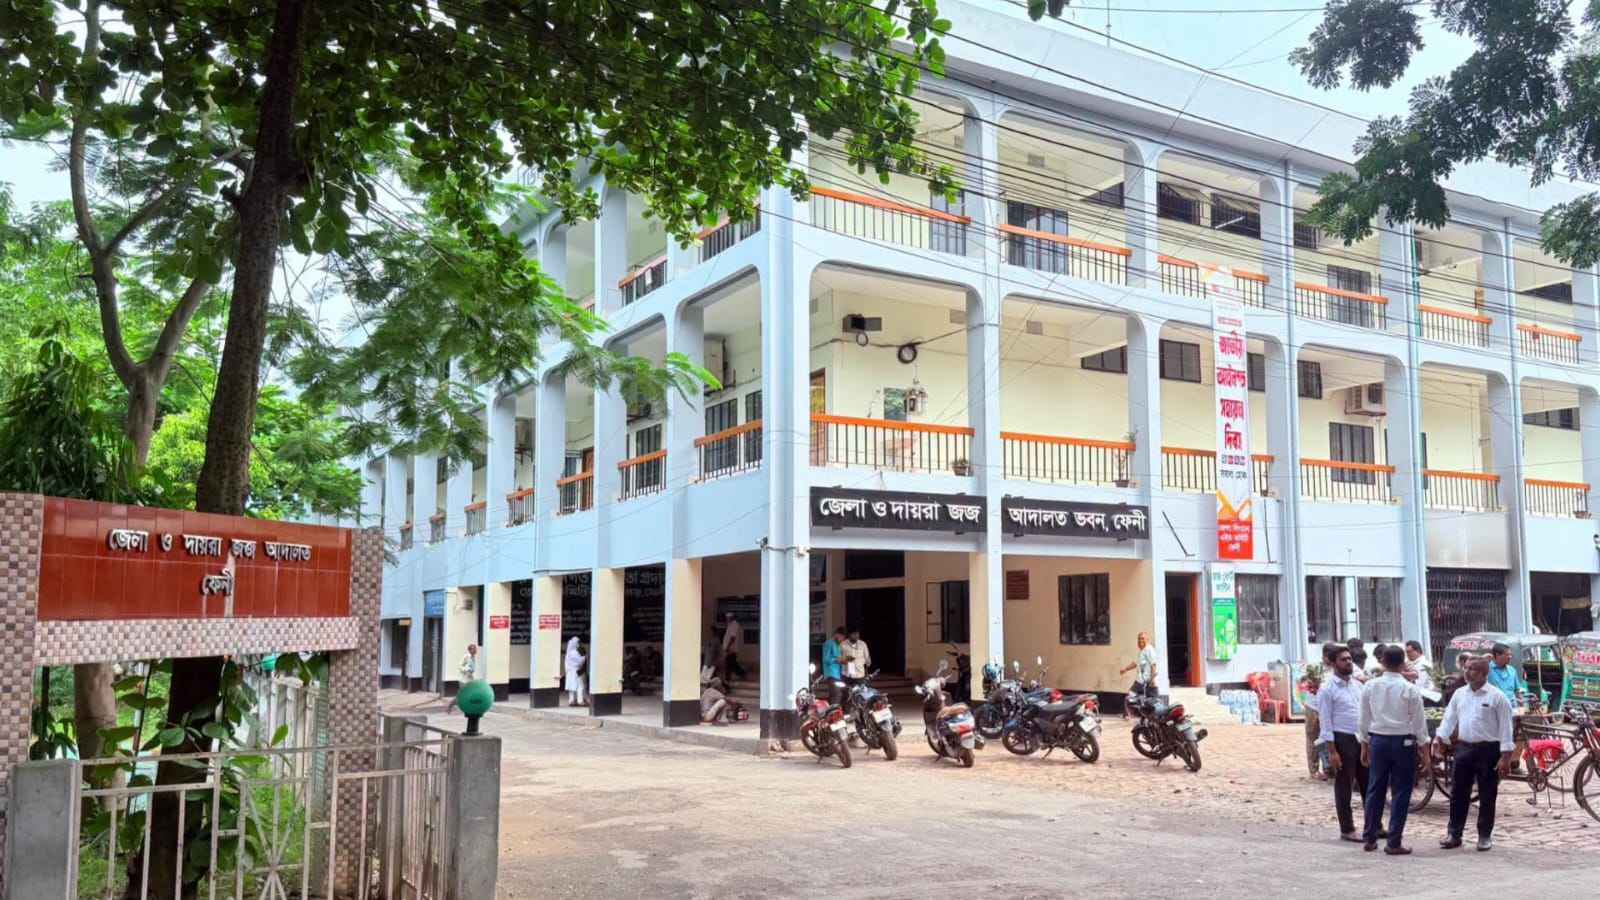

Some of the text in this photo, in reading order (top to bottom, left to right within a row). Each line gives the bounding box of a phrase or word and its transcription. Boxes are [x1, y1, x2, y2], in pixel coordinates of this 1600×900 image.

[819, 496, 981, 523] জেলা ও দায়রা জজ
[1008, 505, 1146, 533] আদালত ভবন, ফেনী
[109, 527, 313, 562] জেলা ও দায়রা জজ আদালত
[201, 568, 234, 596] ফেনী
